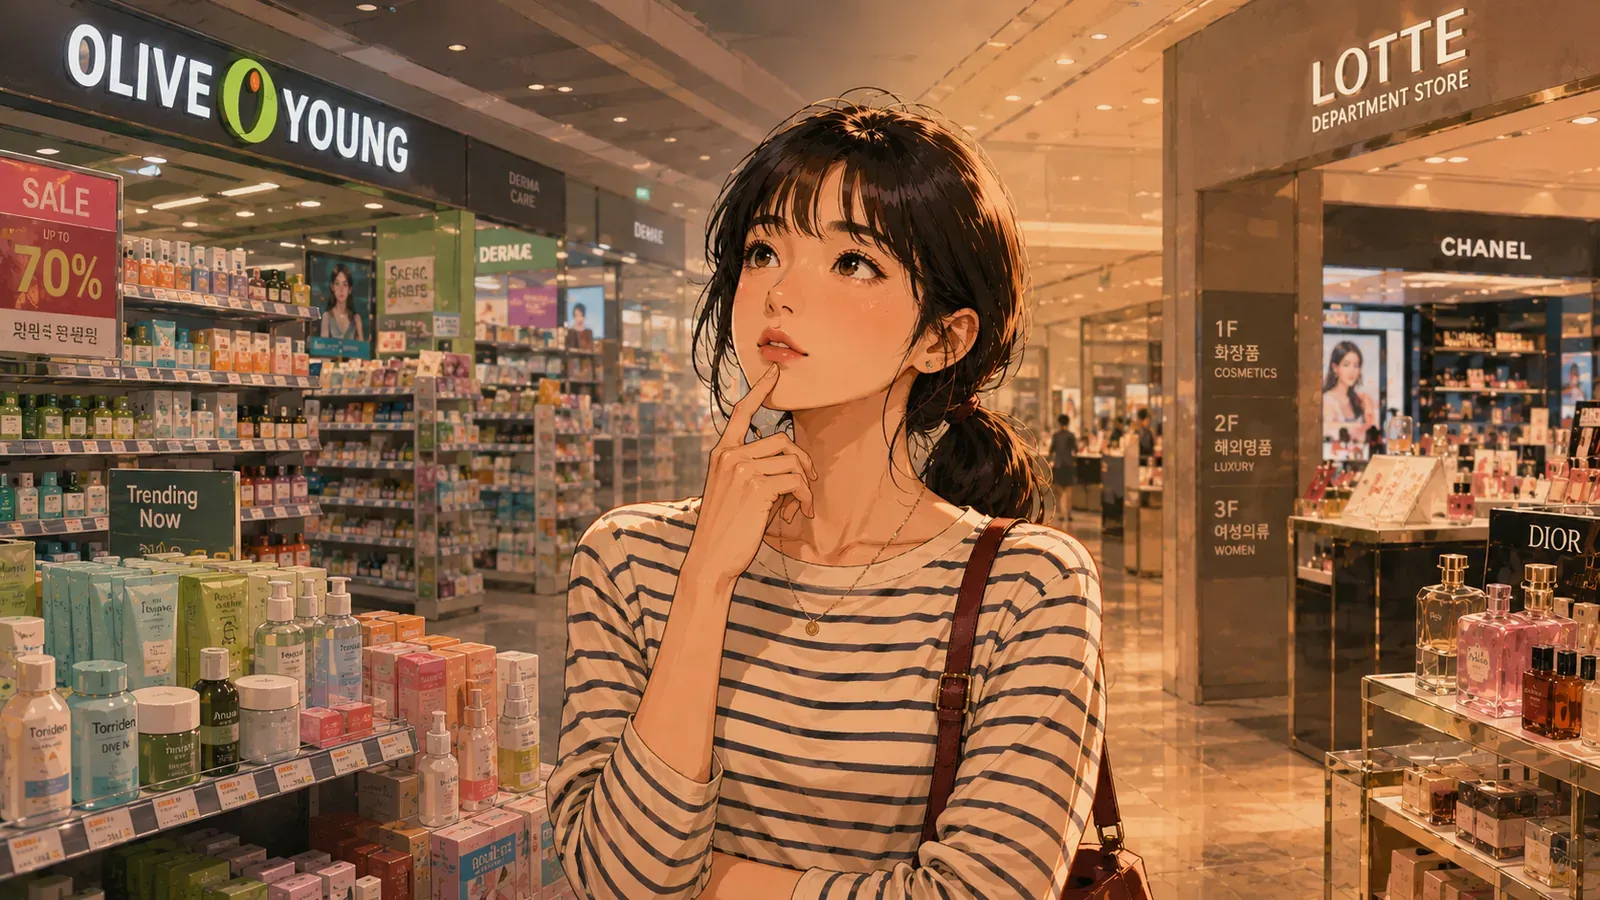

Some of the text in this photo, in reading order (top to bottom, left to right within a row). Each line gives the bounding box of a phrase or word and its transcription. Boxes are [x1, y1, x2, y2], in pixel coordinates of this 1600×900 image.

[1312, 7, 1467, 106] LOTTE
[67, 23, 213, 119] OLIVE
[282, 87, 409, 173] YOUNG
[1311, 68, 1469, 134] DEPARTMENT STORE
[22, 177, 91, 218] SALE
[510, 188, 537, 209] CARE
[43, 228, 70, 243] UP TO
[1440, 236, 1533, 261] CHANEL
[14, 243, 103, 301] 70%
[1215, 319, 1238, 338] 1F
[1214, 344, 1260, 362] 화장품
[1214, 367, 1278, 379] COSMETICS
[1214, 413, 1239, 433] 2F
[1214, 438, 1273, 457] 해외명품
[1214, 461, 1256, 473] LUXURY
[126, 484, 198, 511] Trending
[140, 508, 182, 530] Now
[1214, 500, 1239, 519] 3F
[1214, 523, 1270, 541] 여성의류
[1527, 524, 1583, 555] DIOR
[1214, 544, 1256, 556] WOMEN
[91, 718, 137, 735] Torriden
